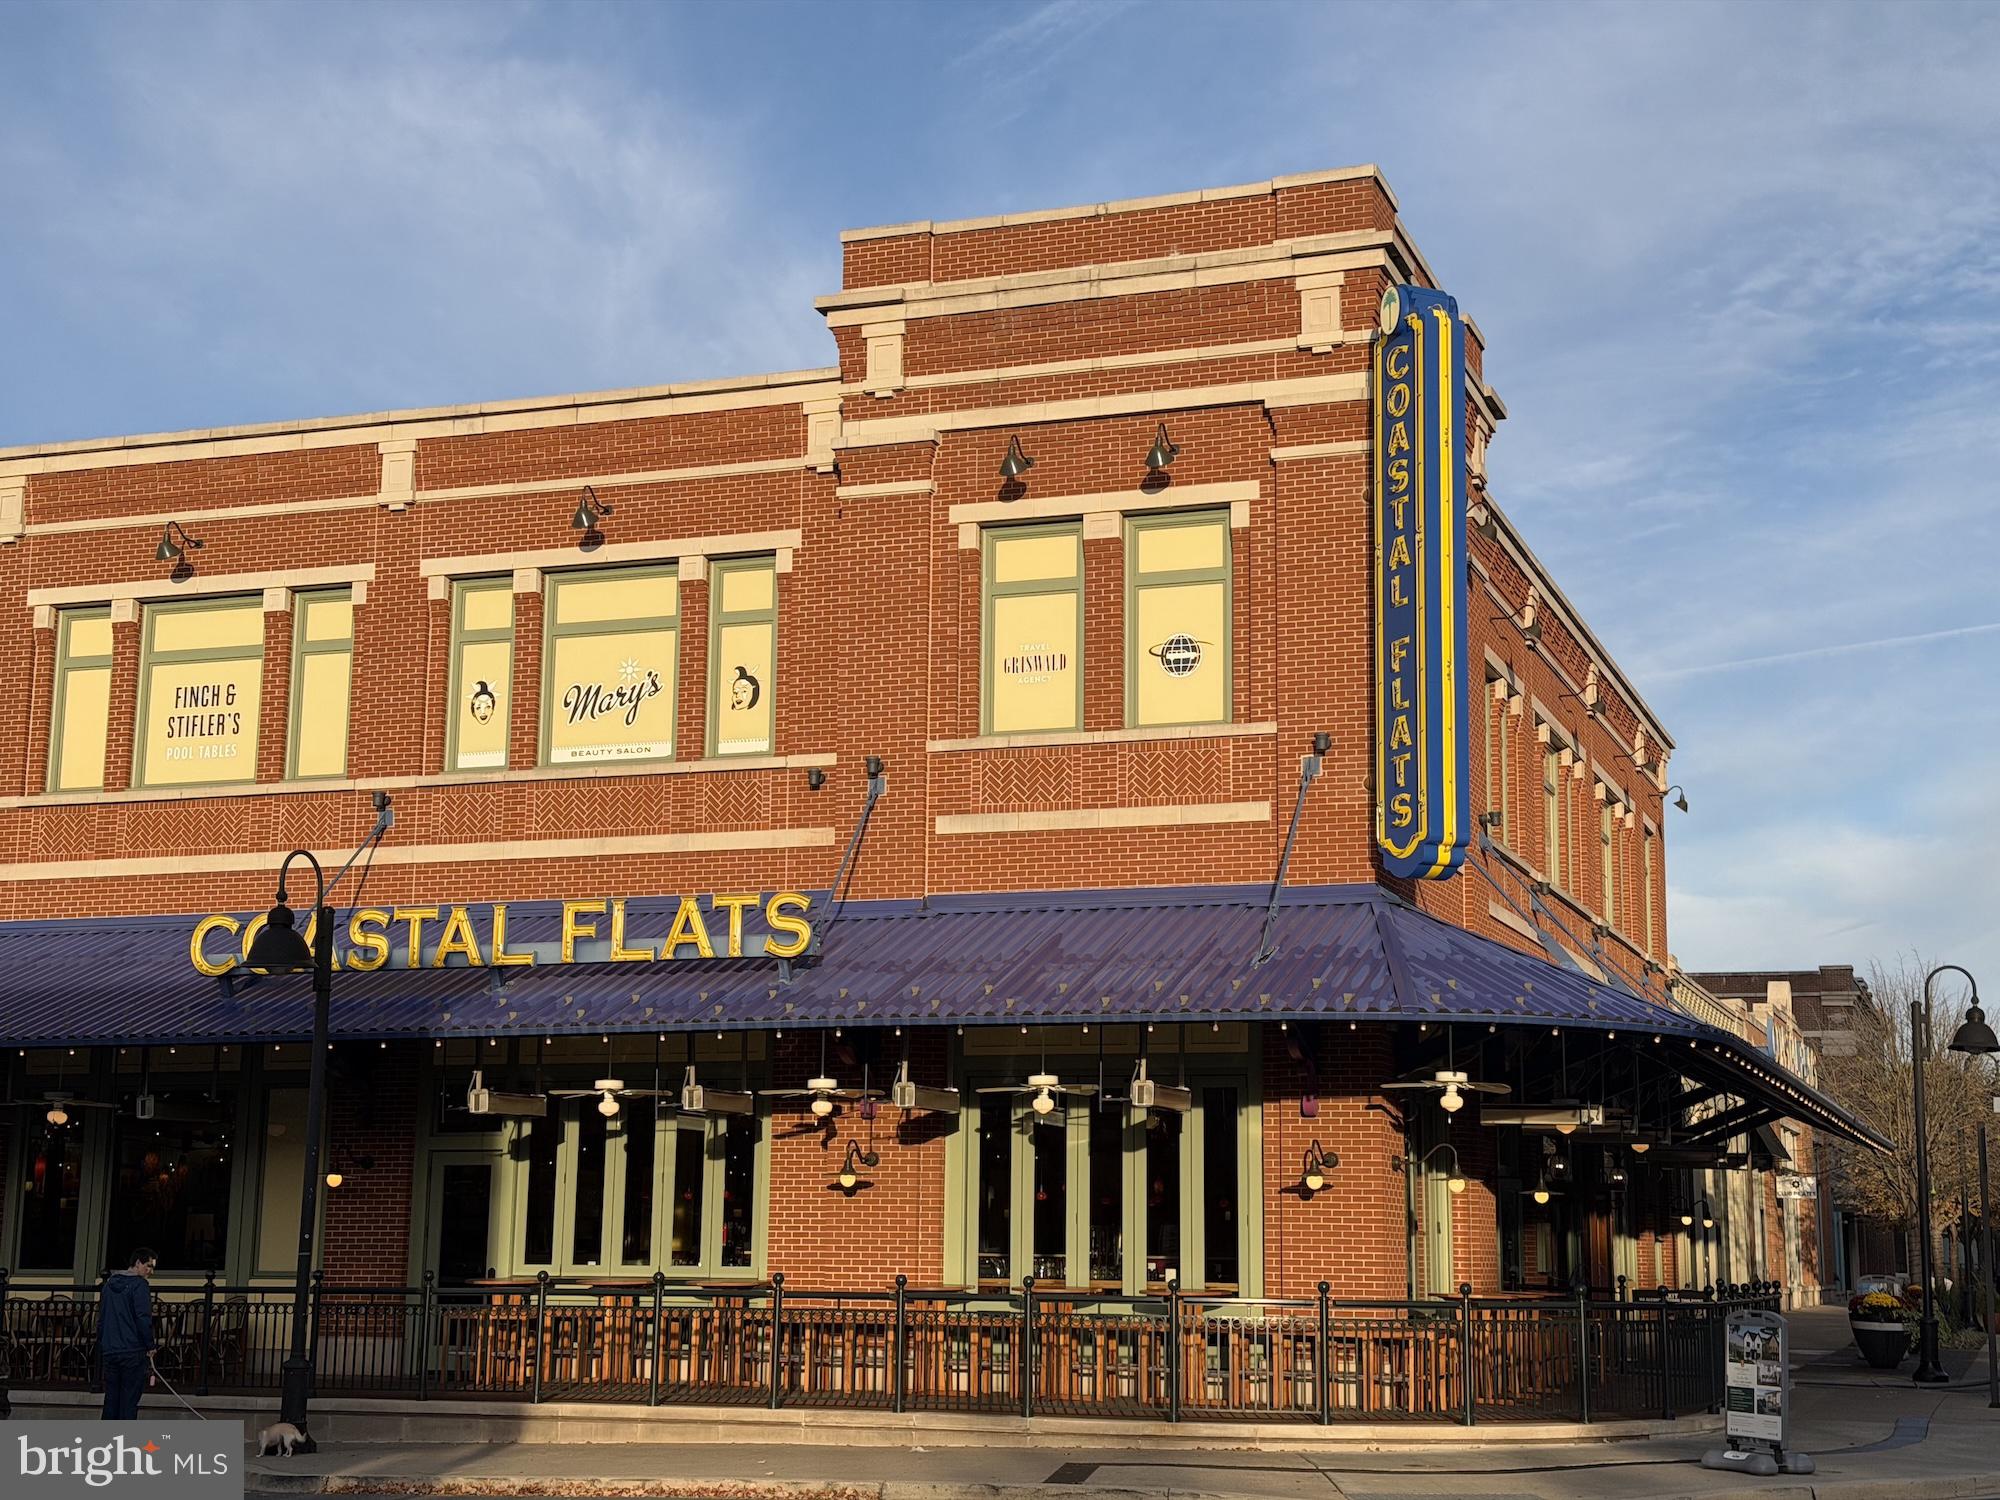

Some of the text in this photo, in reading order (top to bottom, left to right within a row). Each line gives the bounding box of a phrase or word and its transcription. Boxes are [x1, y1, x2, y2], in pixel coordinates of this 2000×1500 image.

[1386, 345, 1412, 828] COASTAL FLATS
[1020, 643, 1050, 652] TRAVEL
[1004, 653, 1066, 674] GRISWALD
[1018, 675, 1051, 685] AGENCY
[175, 683, 237, 709] FINCH &
[563, 670, 663, 726] Mary's
[167, 712, 241, 738] STIFLER'S
[166, 743, 237, 760] POOL TABLES
[570, 746, 651, 758] BEAUTY SALON
[561, 892, 812, 963] FLATS
